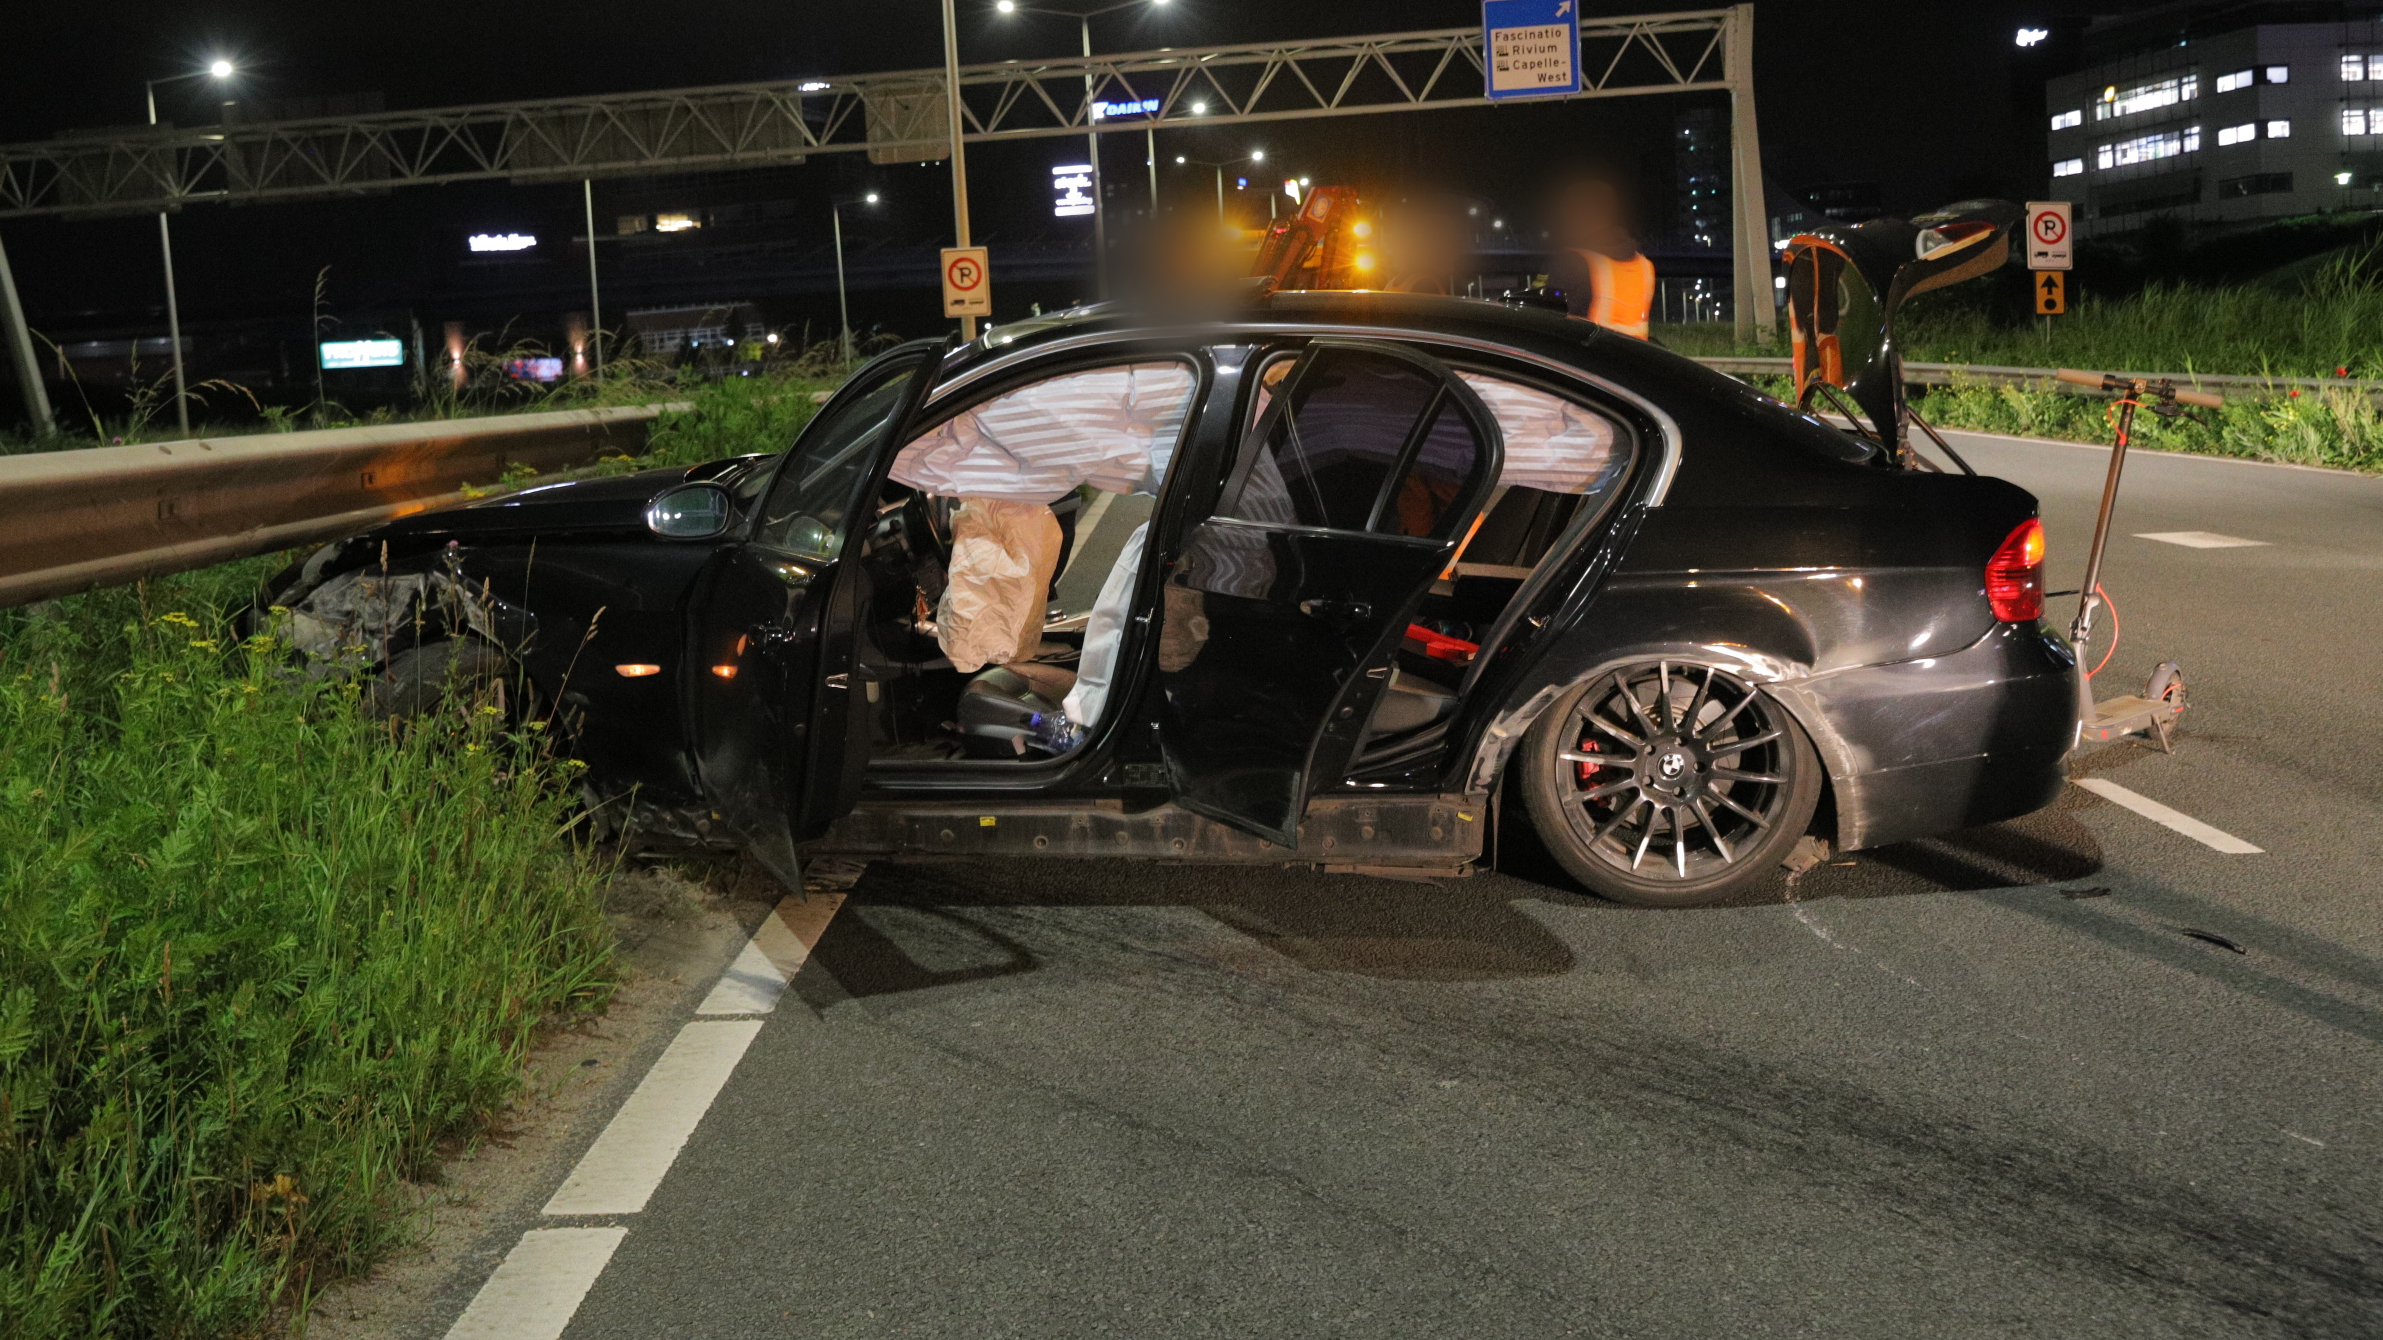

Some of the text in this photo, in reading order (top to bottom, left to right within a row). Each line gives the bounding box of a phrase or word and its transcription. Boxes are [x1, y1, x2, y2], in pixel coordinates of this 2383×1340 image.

[1495, 28, 1562, 42] Fascinatio
[1512, 44, 1558, 56] Rivium
[1513, 58, 1567, 71] Capelle-
[1537, 72, 1567, 83] West
[2045, 220, 2056, 236] P
[960, 267, 972, 284] P
